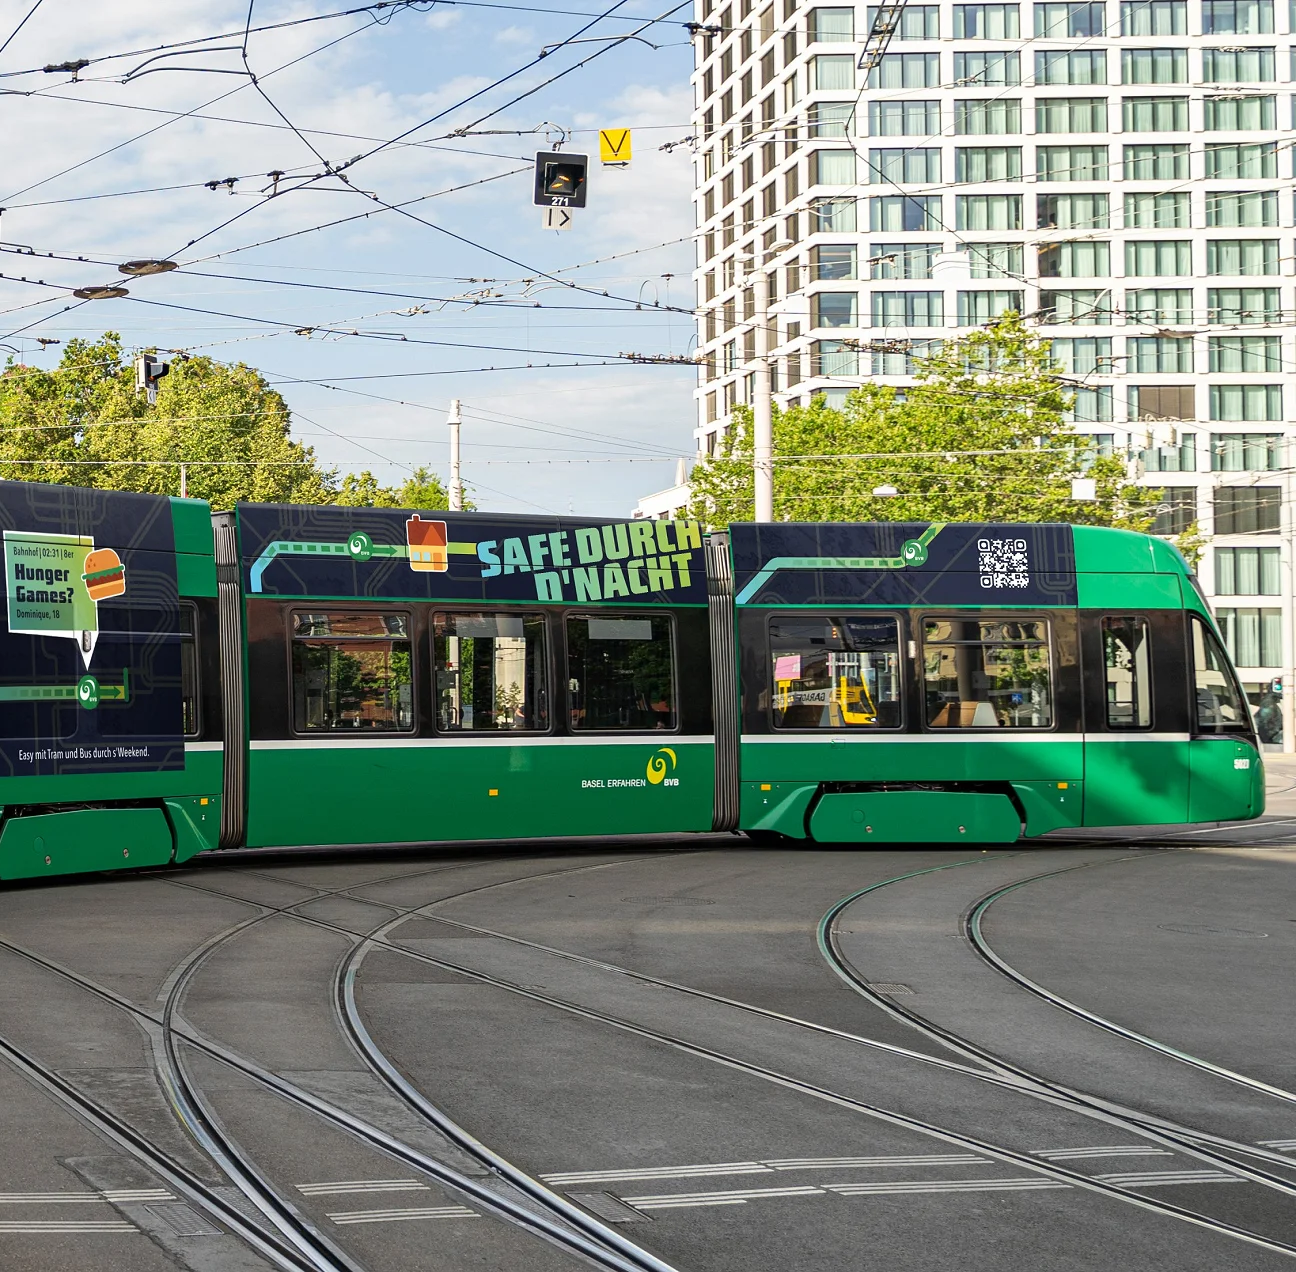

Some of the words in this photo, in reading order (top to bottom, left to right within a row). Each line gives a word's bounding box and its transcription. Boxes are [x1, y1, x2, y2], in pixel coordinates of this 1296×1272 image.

[551, 196, 569, 207] 271
[13, 546, 39, 557] Bahnhof
[42, 548, 60, 558] 02:31
[63, 549, 74, 559] 8er
[477, 530, 572, 578] SAFE
[574, 519, 702, 565] DURCH
[14, 563, 70, 586] Hunger
[533, 552, 693, 602] D'NACHT
[15, 585, 75, 604] Games?
[16, 609, 52, 621] Dominique,
[52, 610, 60, 619] 18
[18, 749, 34, 763] Easy
[35, 749, 47, 760] mit
[47, 748, 64, 760] Tram
[64, 747, 78, 759] und
[79, 748, 92, 759] Bus
[92, 747, 112, 758] durch
[112, 746, 150, 758] s'Weekend.
[581, 779, 605, 788] BASEL
[607, 778, 646, 788] ERFAHREN
[663, 778, 679, 787] BVB
